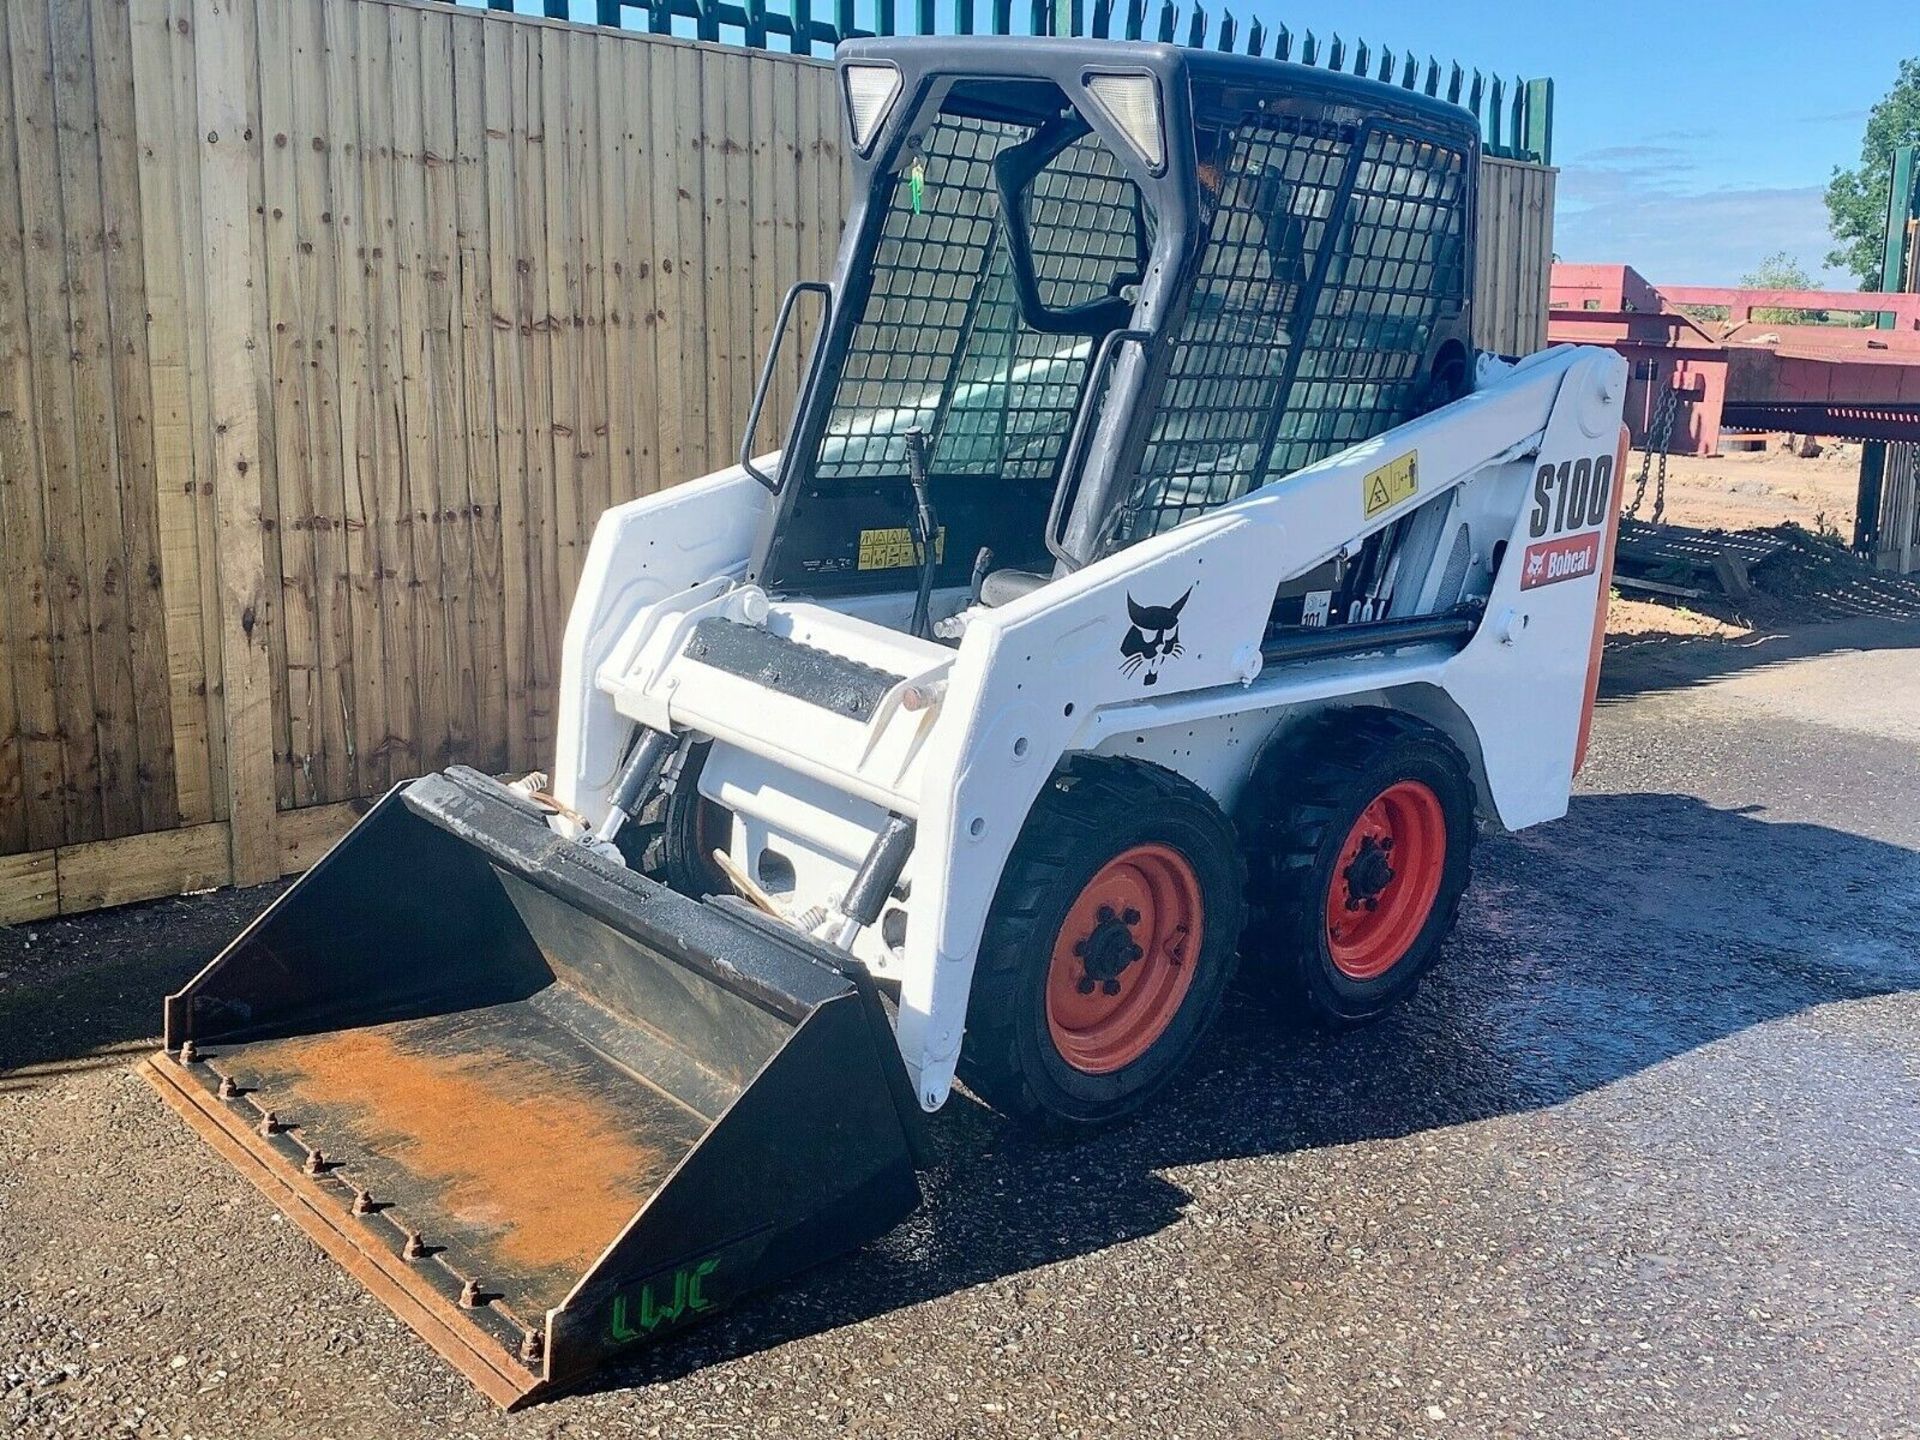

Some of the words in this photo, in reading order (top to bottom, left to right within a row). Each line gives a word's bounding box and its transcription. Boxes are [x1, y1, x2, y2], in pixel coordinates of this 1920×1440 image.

[1529, 455, 1613, 538] S100
[1547, 545, 1591, 579] Bobcat
[611, 1258, 721, 1343] LWC
